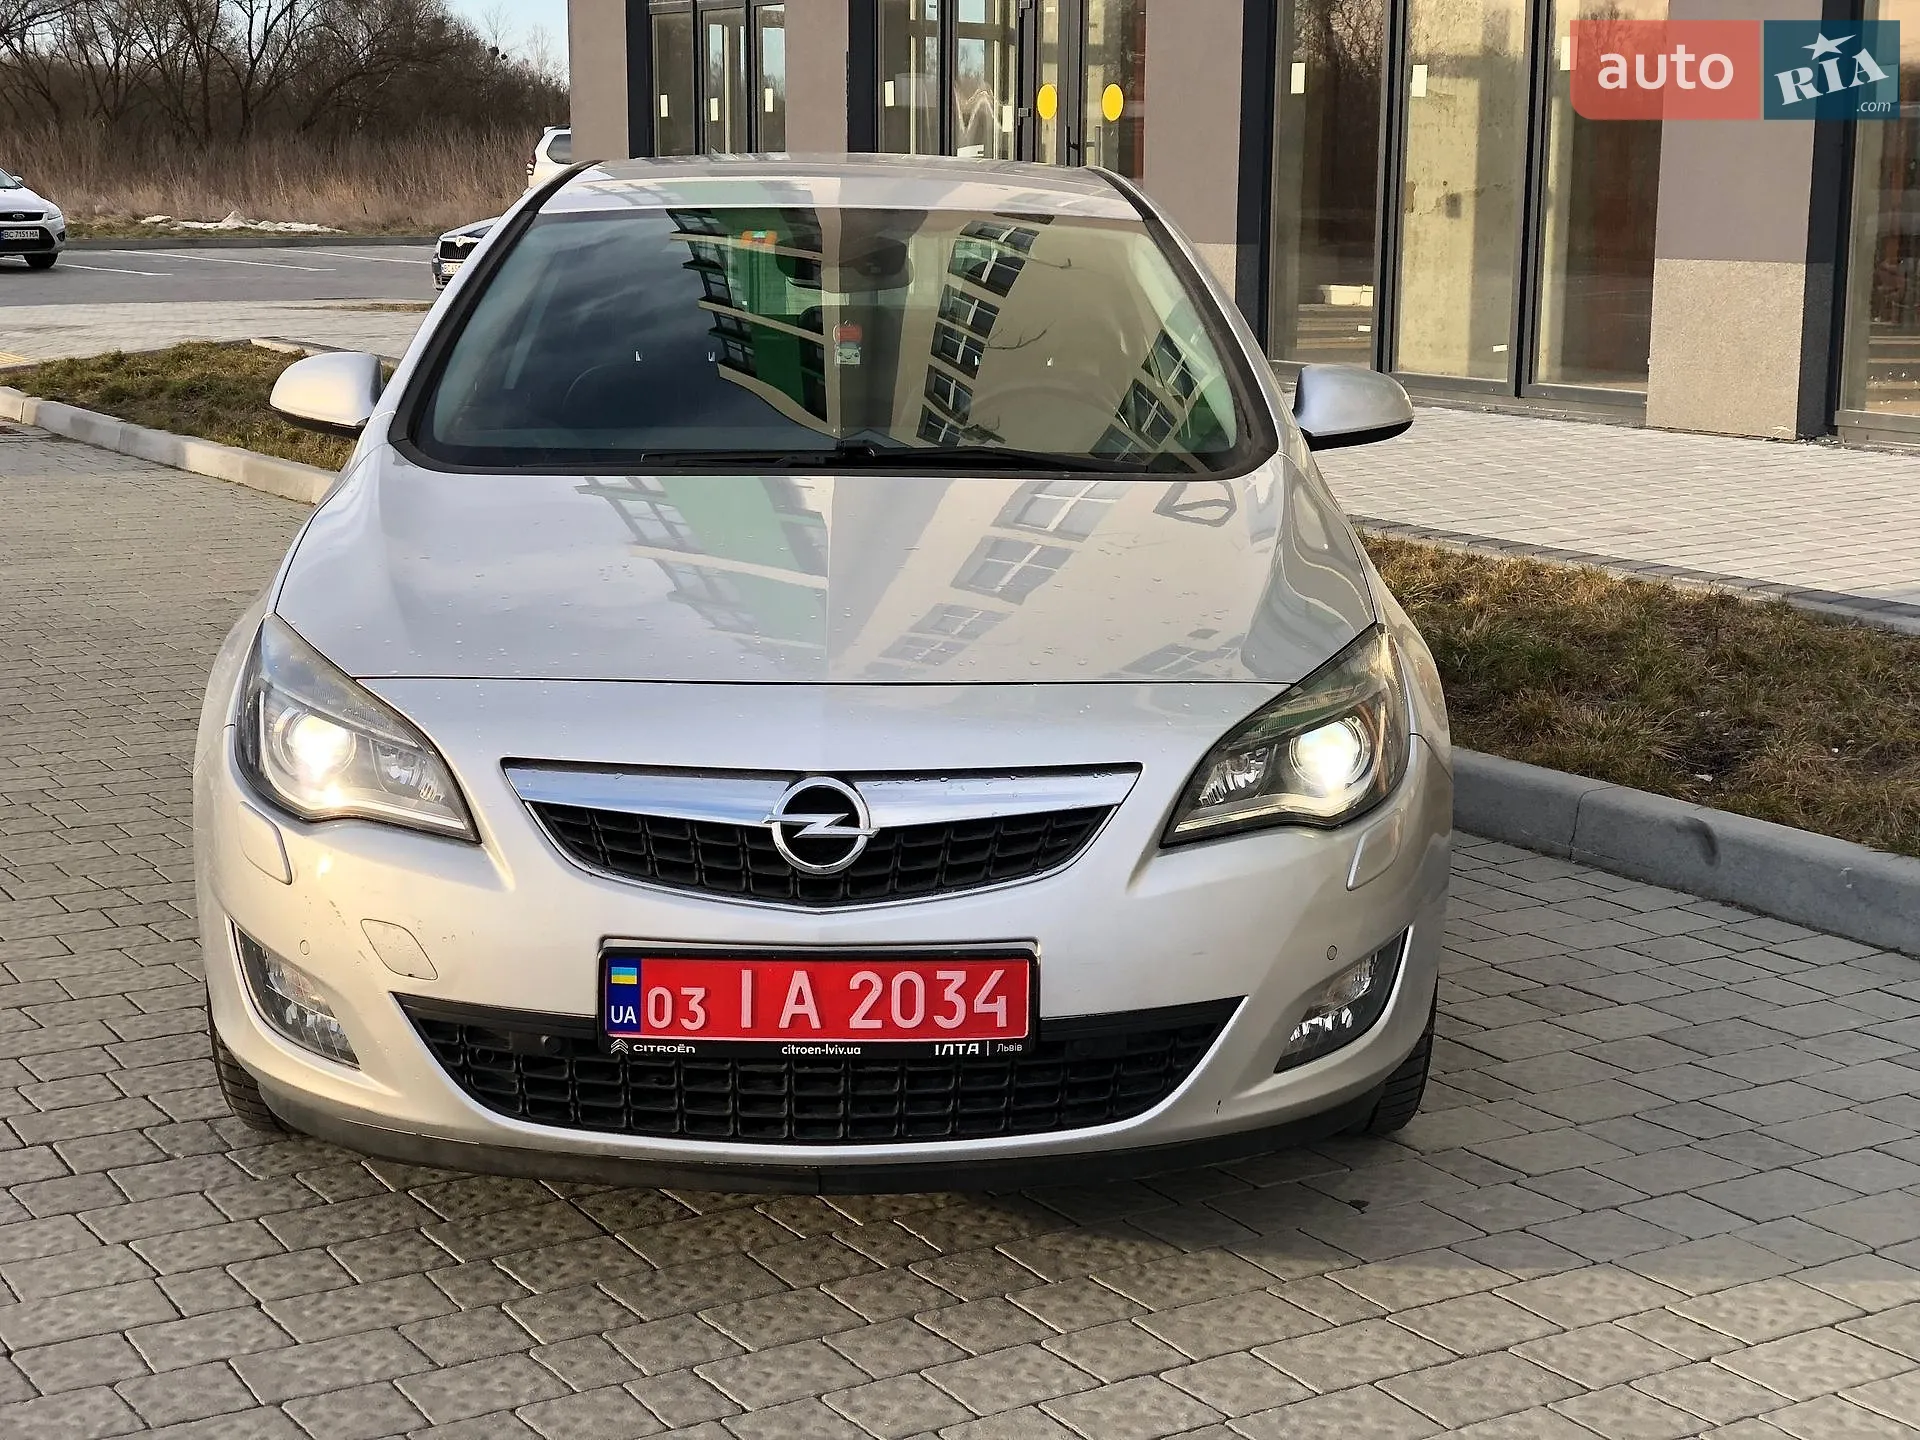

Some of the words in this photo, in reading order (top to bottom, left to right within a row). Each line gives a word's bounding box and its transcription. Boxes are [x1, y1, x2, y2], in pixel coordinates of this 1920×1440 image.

[647, 987, 706, 1031] 03
[848, 969, 1008, 1030] 2034
[610, 1005, 637, 1024] UA
[781, 1043, 861, 1056] citroen-lviv.ua
